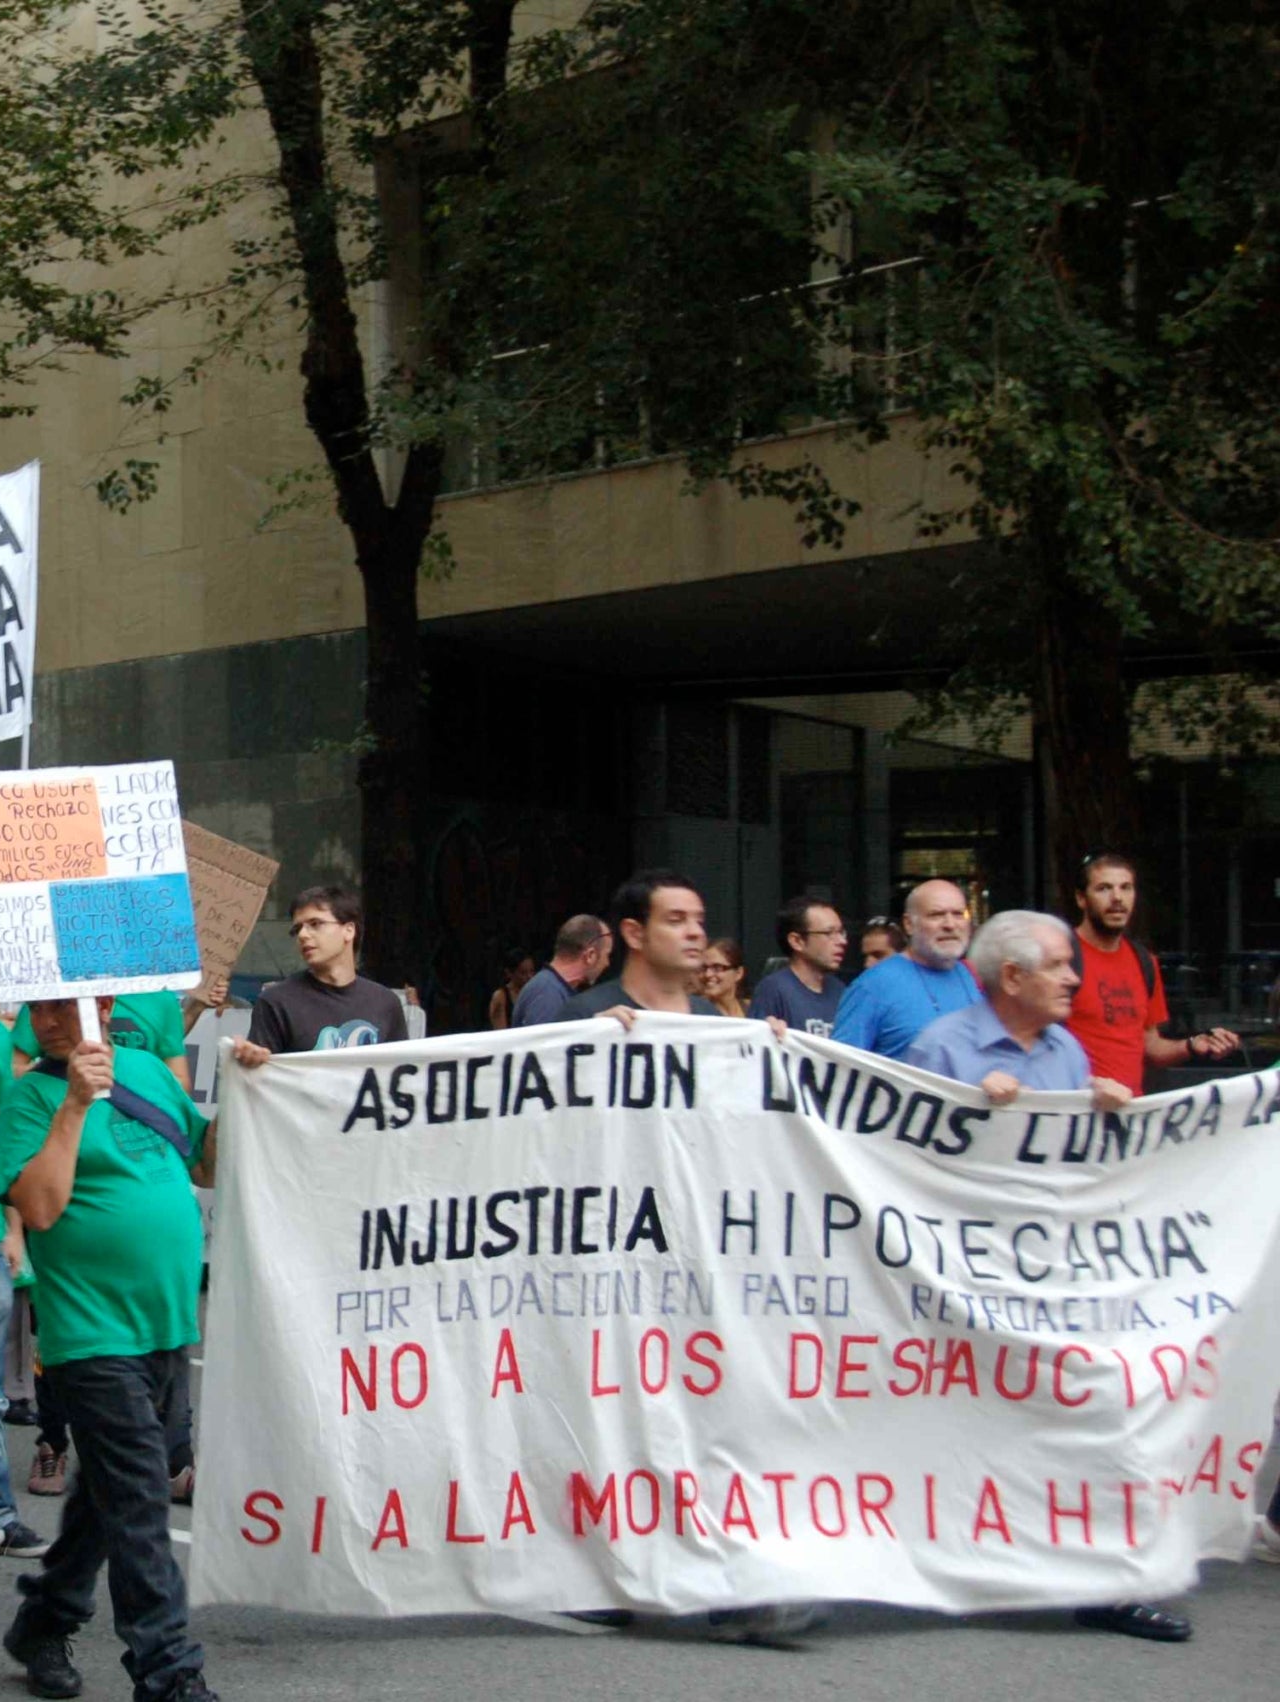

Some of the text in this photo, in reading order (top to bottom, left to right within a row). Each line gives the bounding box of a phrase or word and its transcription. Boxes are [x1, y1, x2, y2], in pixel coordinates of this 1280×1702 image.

[58, 907, 171, 932] NOTARIOS
[342, 1043, 695, 1133] ASOCIACION
[1016, 1084, 1224, 1164] CONTRA
[359, 1186, 669, 1271] INJUSTICIA
[336, 1285, 411, 1334] POR
[489, 1270, 642, 1319] DACION
[660, 1269, 714, 1318] EN
[741, 1273, 850, 1318] PAGO
[340, 1341, 429, 1416] NO
[490, 1326, 525, 1399] A
[590, 1326, 725, 1398] LOS
[569, 1467, 1013, 1546] MORATORIA
